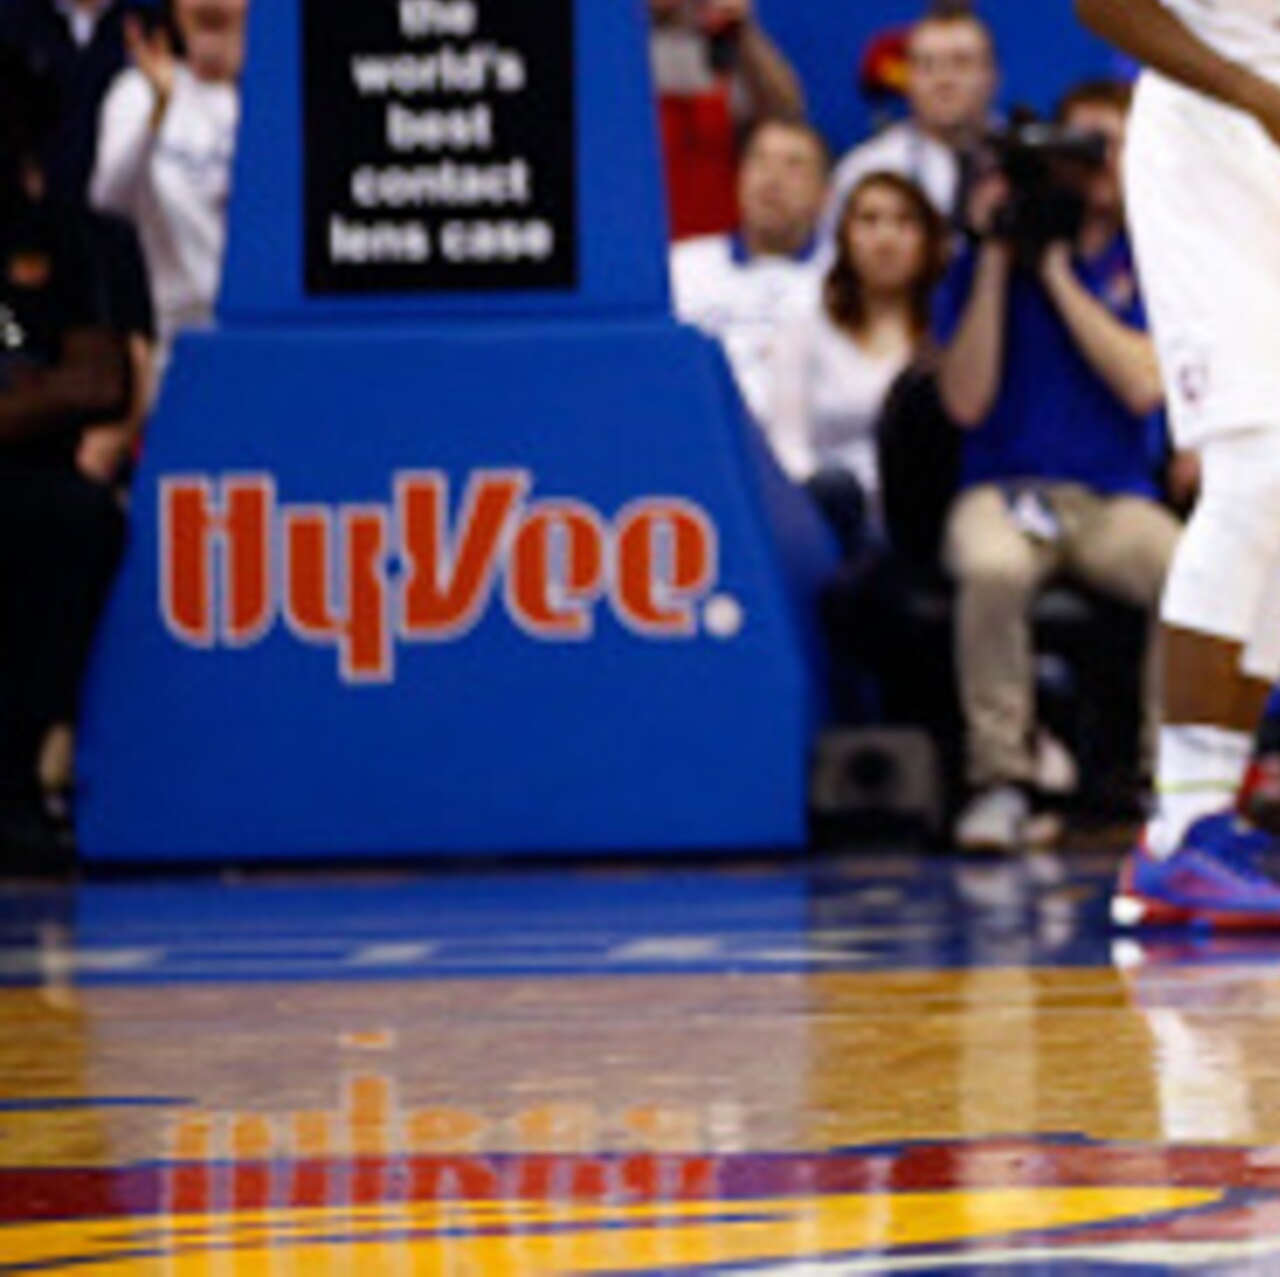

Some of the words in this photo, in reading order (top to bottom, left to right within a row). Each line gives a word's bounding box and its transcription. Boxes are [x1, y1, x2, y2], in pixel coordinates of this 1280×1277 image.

[351, 42, 525, 96] world's
[386, 102, 492, 152] best
[351, 158, 530, 208] contact
[329, 214, 430, 264] lens
[440, 218, 553, 263] case
